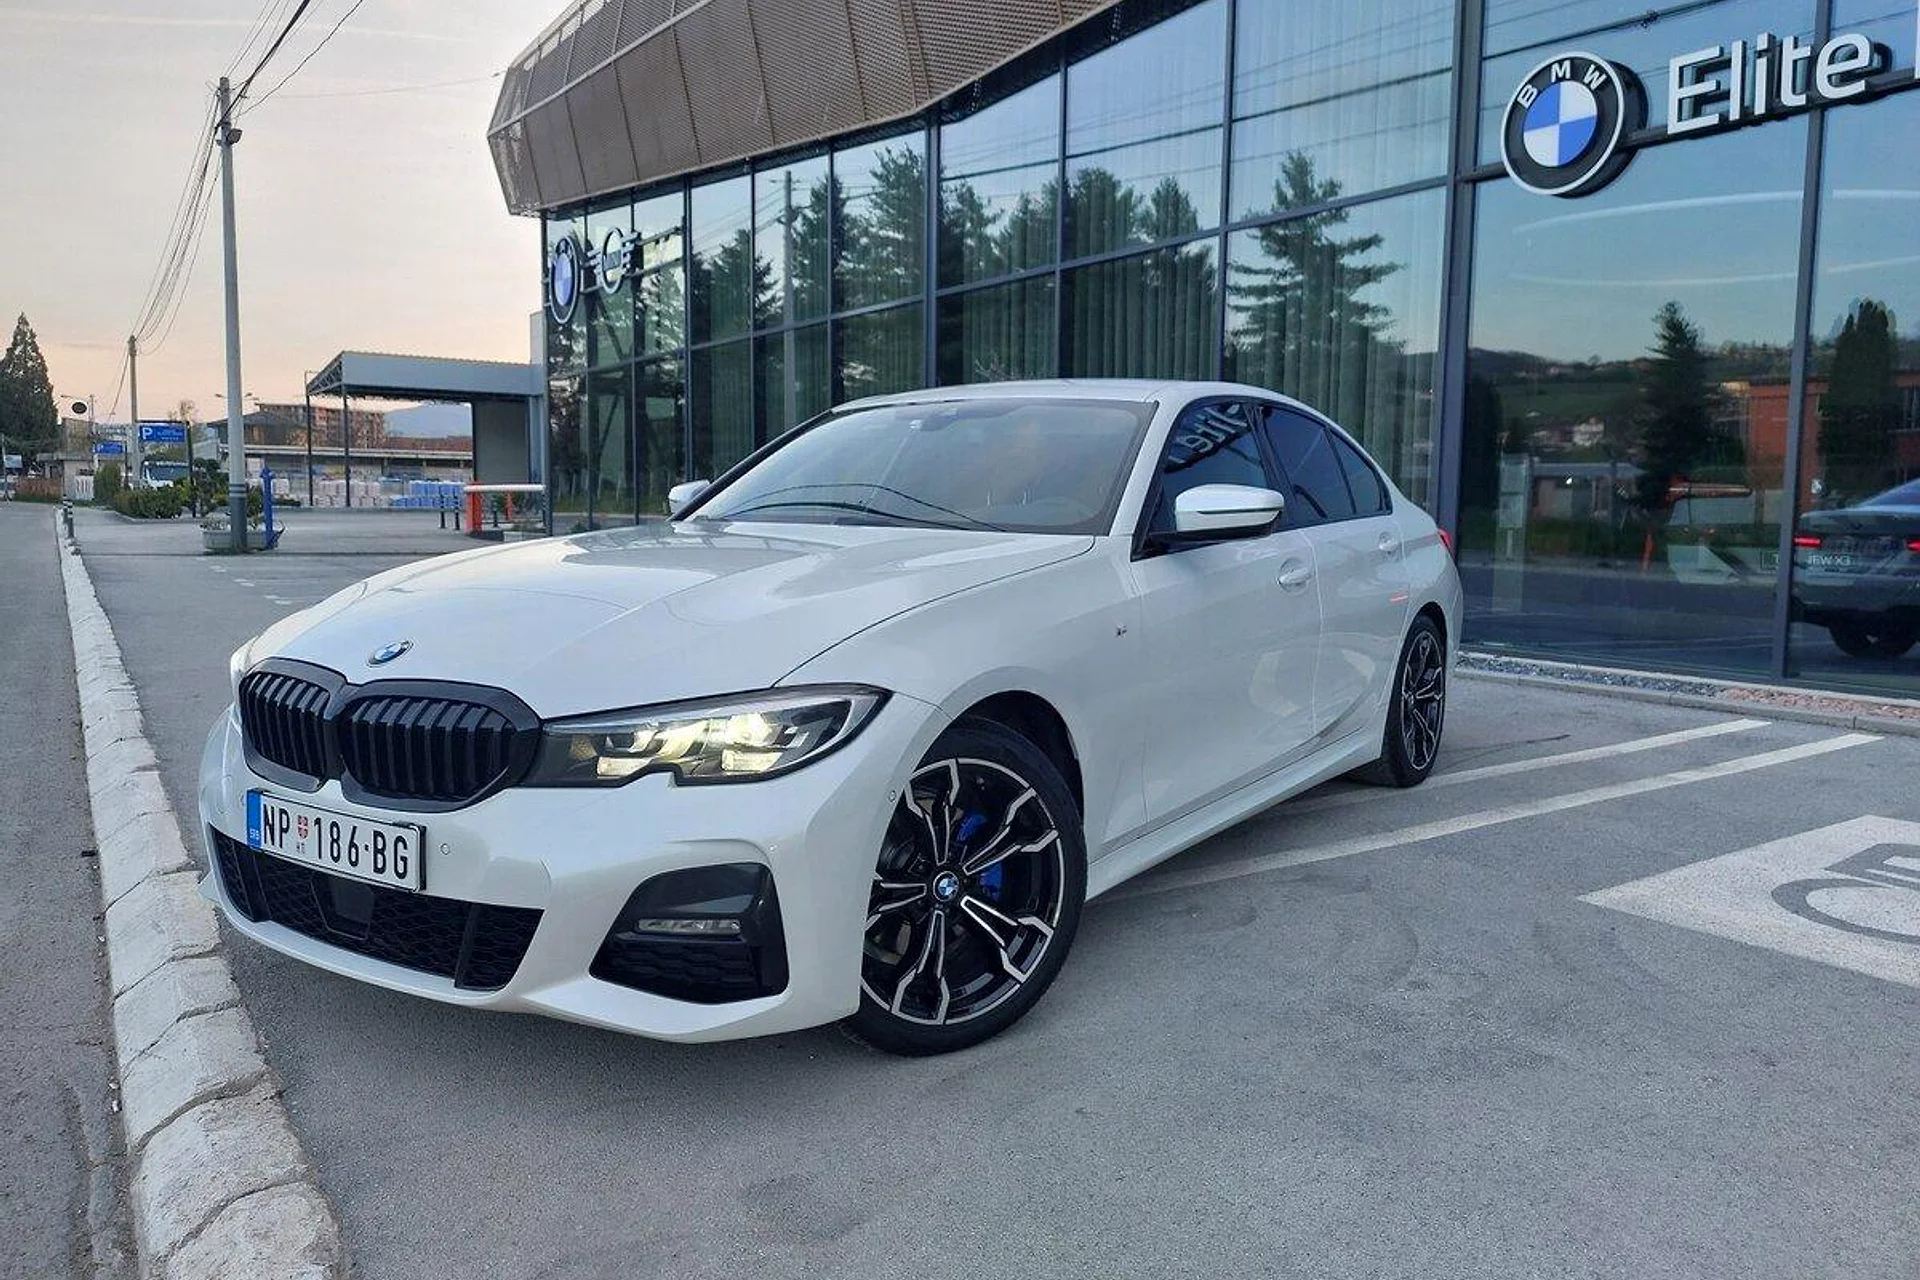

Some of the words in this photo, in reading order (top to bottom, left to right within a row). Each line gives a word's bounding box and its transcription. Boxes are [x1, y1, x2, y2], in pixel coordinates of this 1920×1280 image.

[1517, 60, 1607, 109] BMW
[1667, 31, 1872, 135] Elite
[142, 427, 153, 440] P
[263, 803, 290, 849] NP
